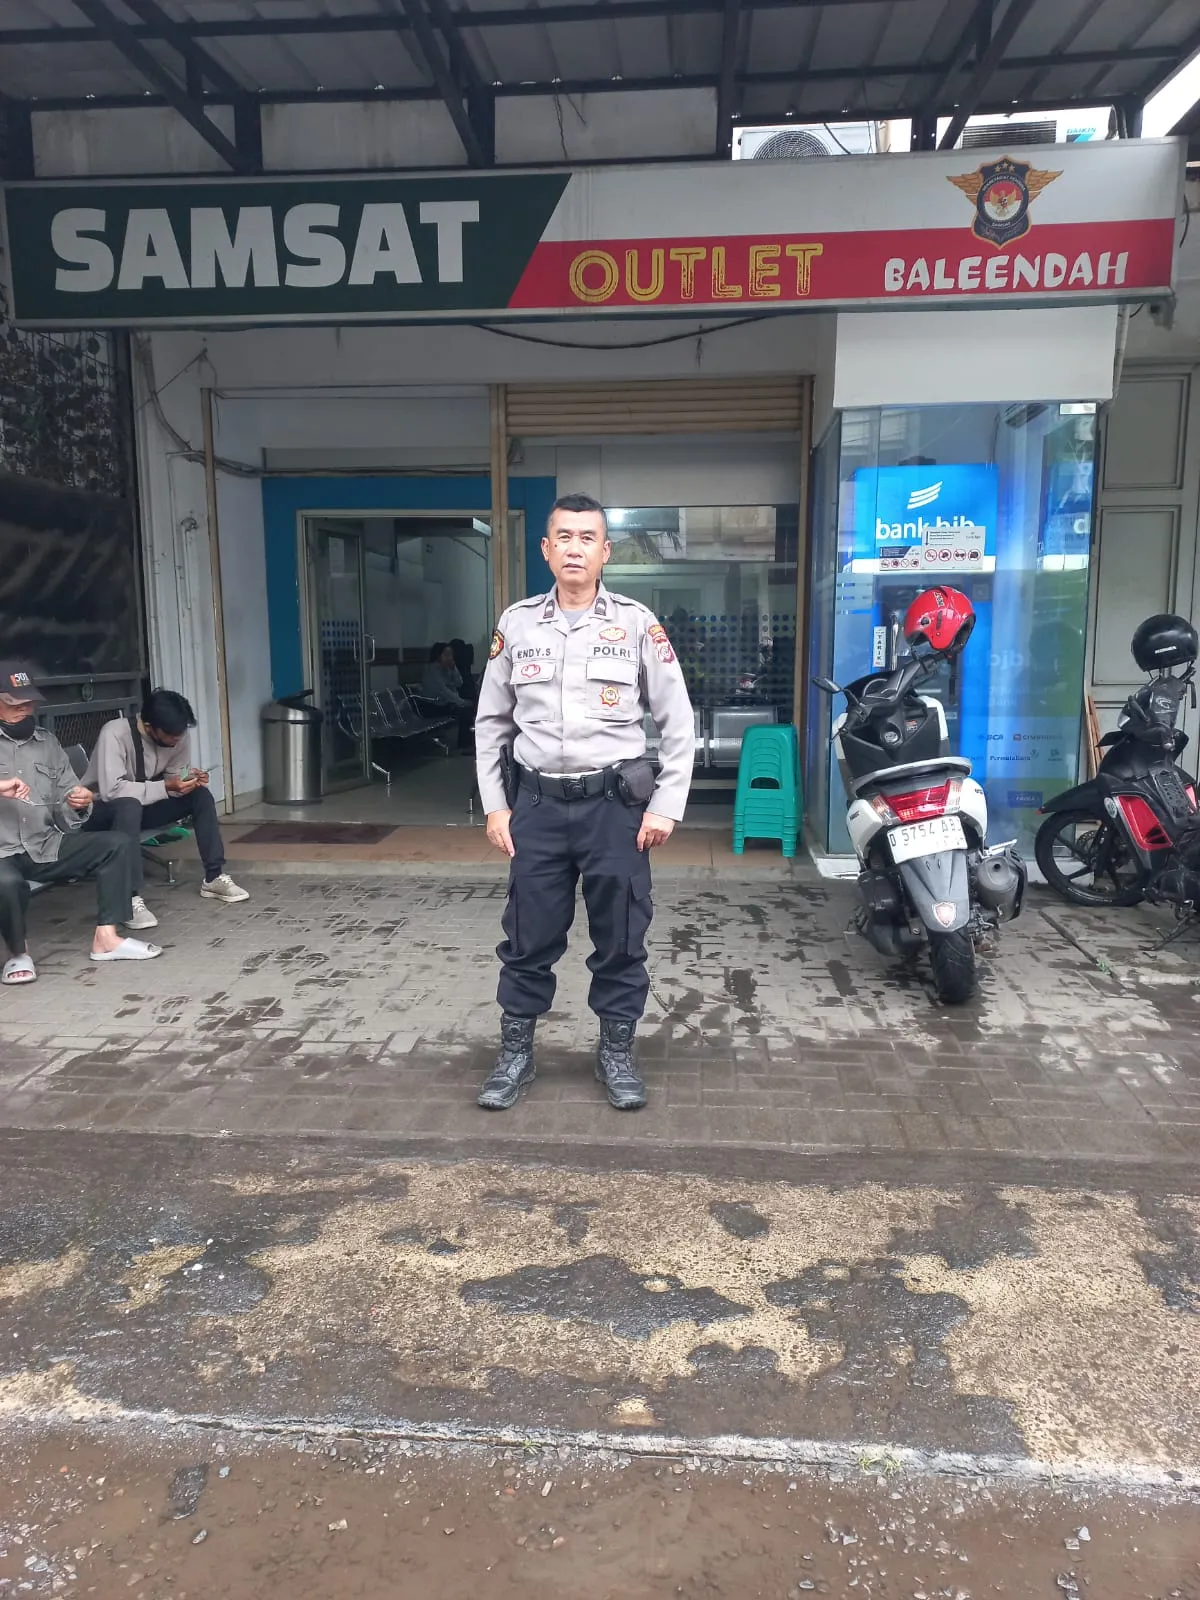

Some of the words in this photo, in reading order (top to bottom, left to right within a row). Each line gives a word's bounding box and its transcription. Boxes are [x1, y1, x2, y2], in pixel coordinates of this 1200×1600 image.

[51, 200, 480, 292] SAMSAT
[569, 243, 824, 303] OUTLET
[885, 251, 1129, 292] BALEENDAH
[517, 647, 552, 659] ENDY.S
[593, 646, 631, 658] POLRI
